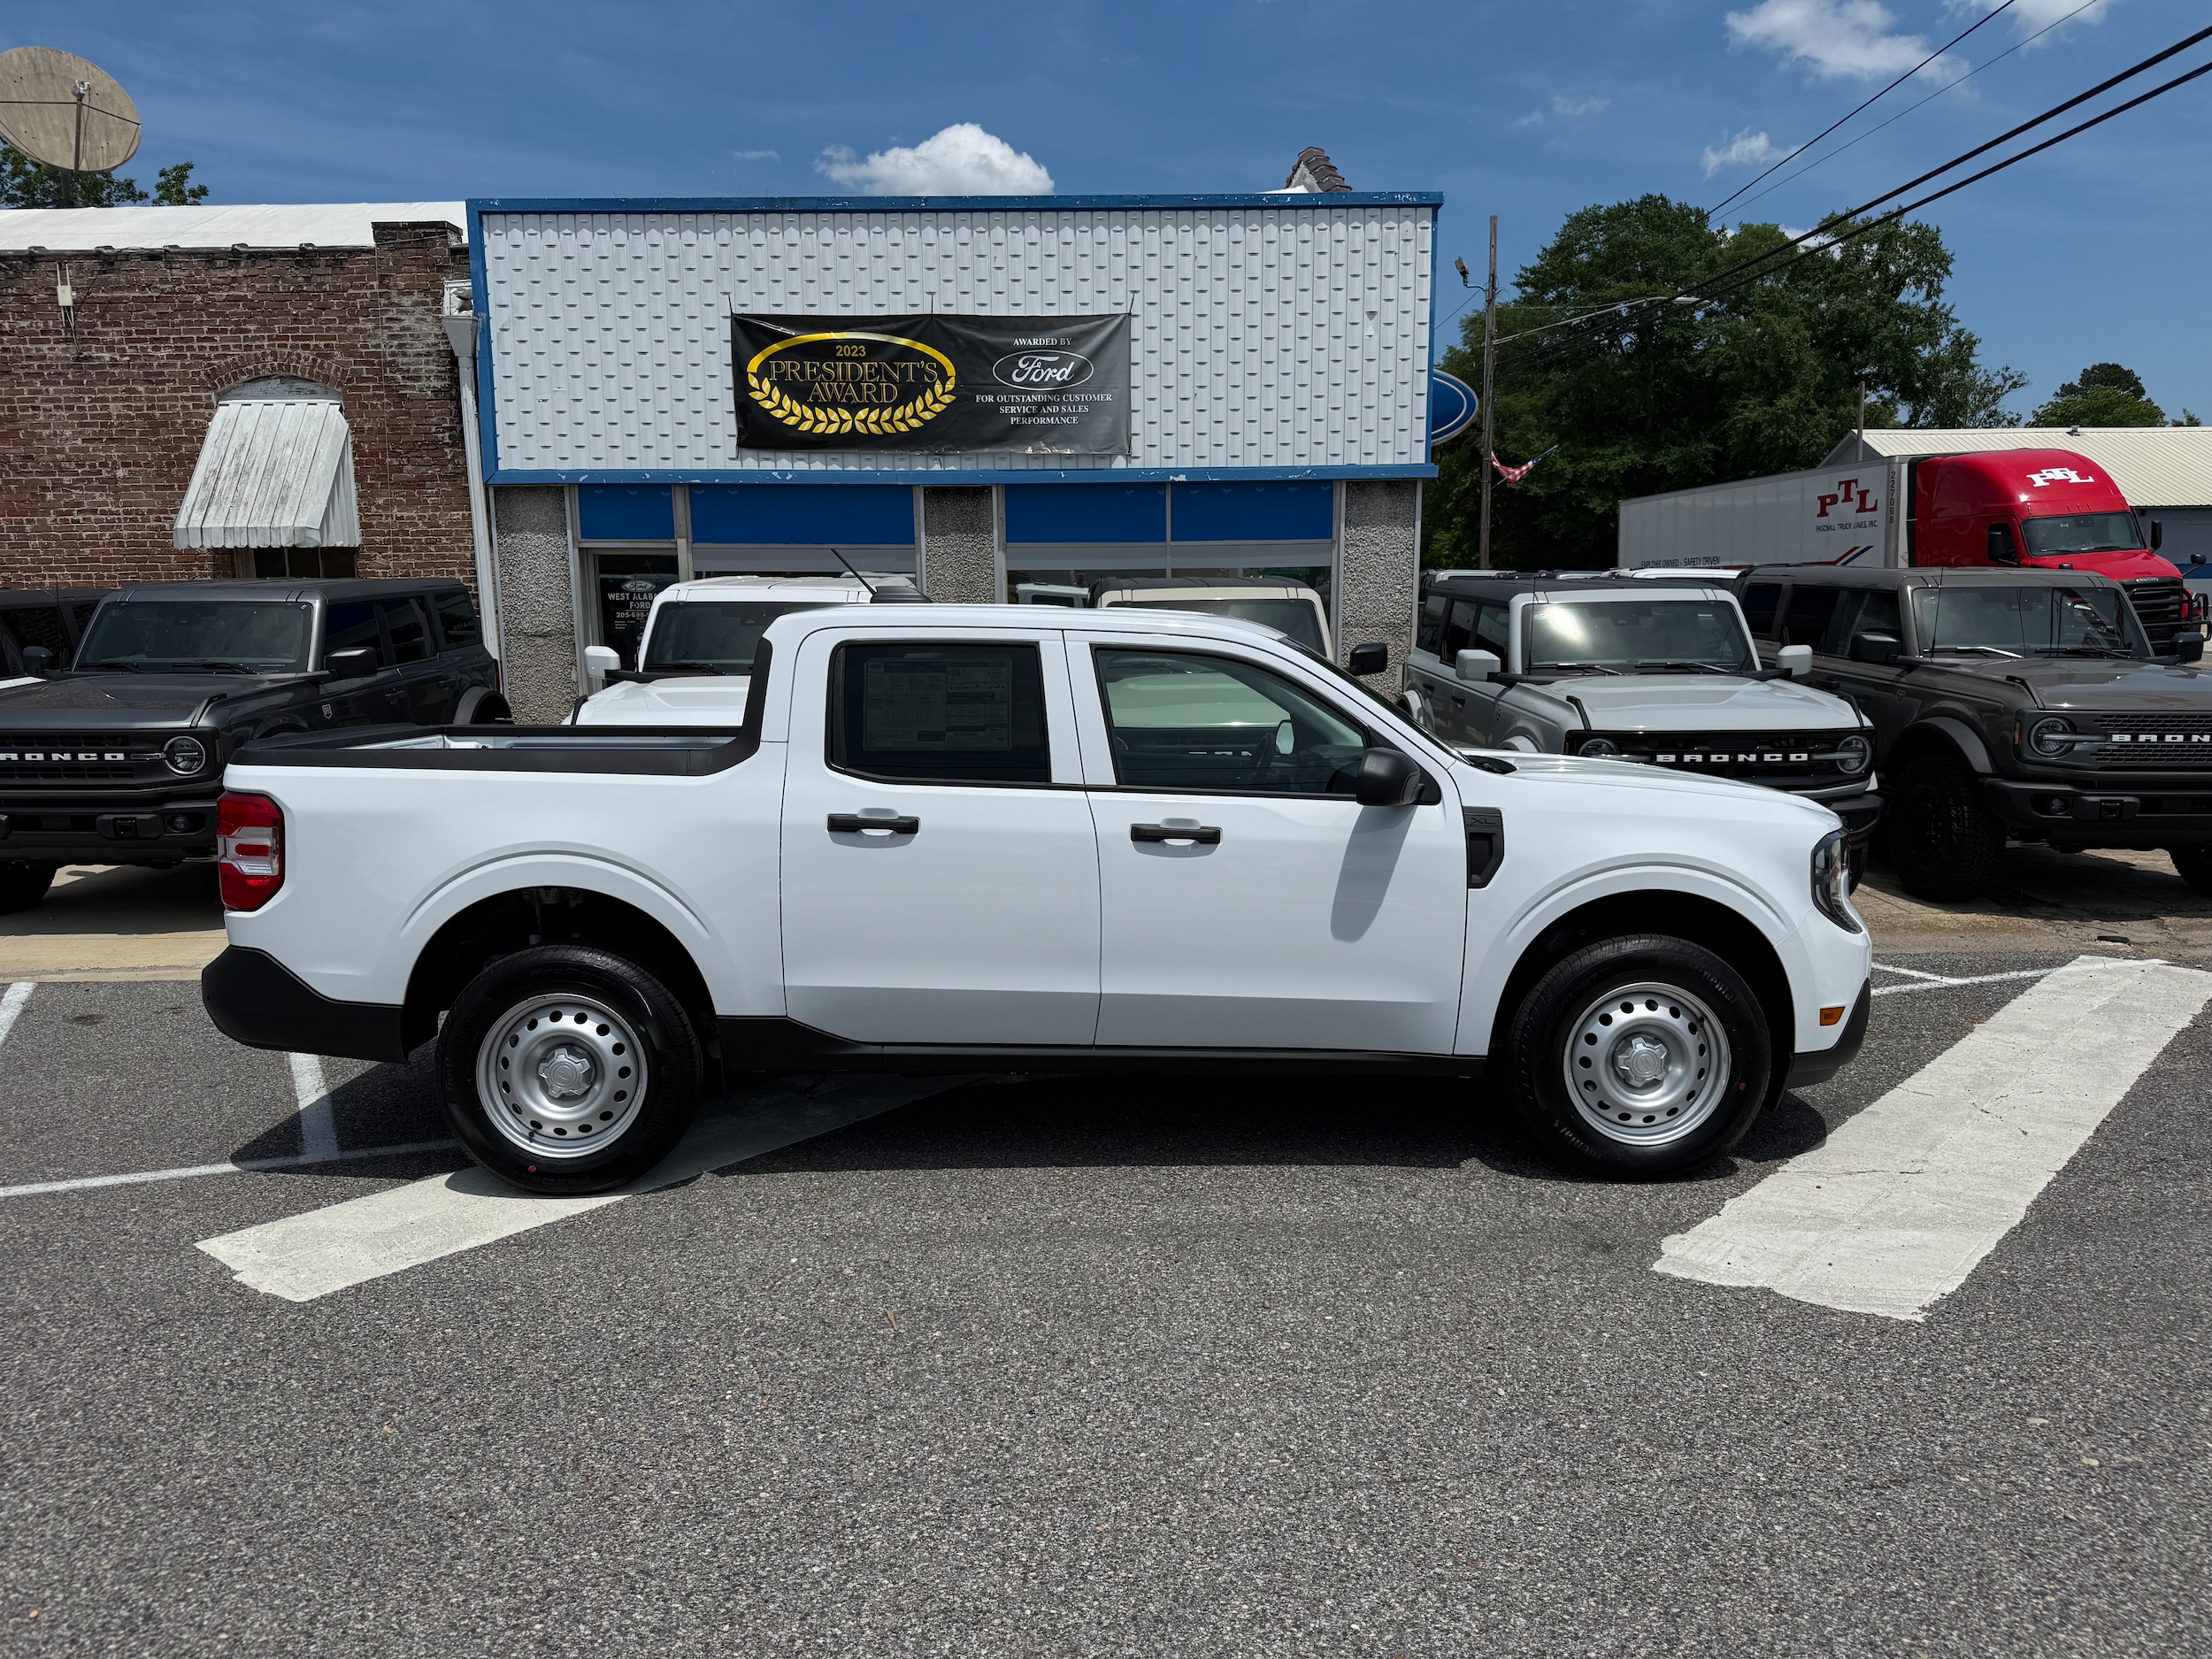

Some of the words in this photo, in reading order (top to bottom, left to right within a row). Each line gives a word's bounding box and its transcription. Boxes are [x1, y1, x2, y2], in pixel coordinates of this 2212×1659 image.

[1013, 337, 1057, 346] AWARDED
[1060, 337, 1072, 346] BY
[835, 344, 866, 357] 2023
[768, 360, 938, 382] PRESIDENT'S
[1011, 355, 1075, 382] Ford
[806, 381, 899, 404] AWARD
[975, 394, 995, 403] FOR
[996, 394, 1061, 403] OUTSTANDING
[1062, 393, 1113, 402] CUSTOMER
[999, 405, 1039, 414] SERVICE
[1040, 404, 1060, 413] AND
[1061, 404, 1089, 413] SALES
[1010, 416, 1079, 425] PERFORMANCE
[2025, 467, 2095, 487] PTL
[1816, 479, 1878, 518] PTL
[1837, 522, 1852, 531] TRUCK
[1663, 558, 1679, 567] OWNED
[1683, 557, 1701, 566] SAFETY
[1702, 556, 1720, 565] DRIVEN
[607, 592, 630, 601] WEST
[1655, 753, 1809, 763] BRONCO
[1471, 817, 1497, 826] XL
